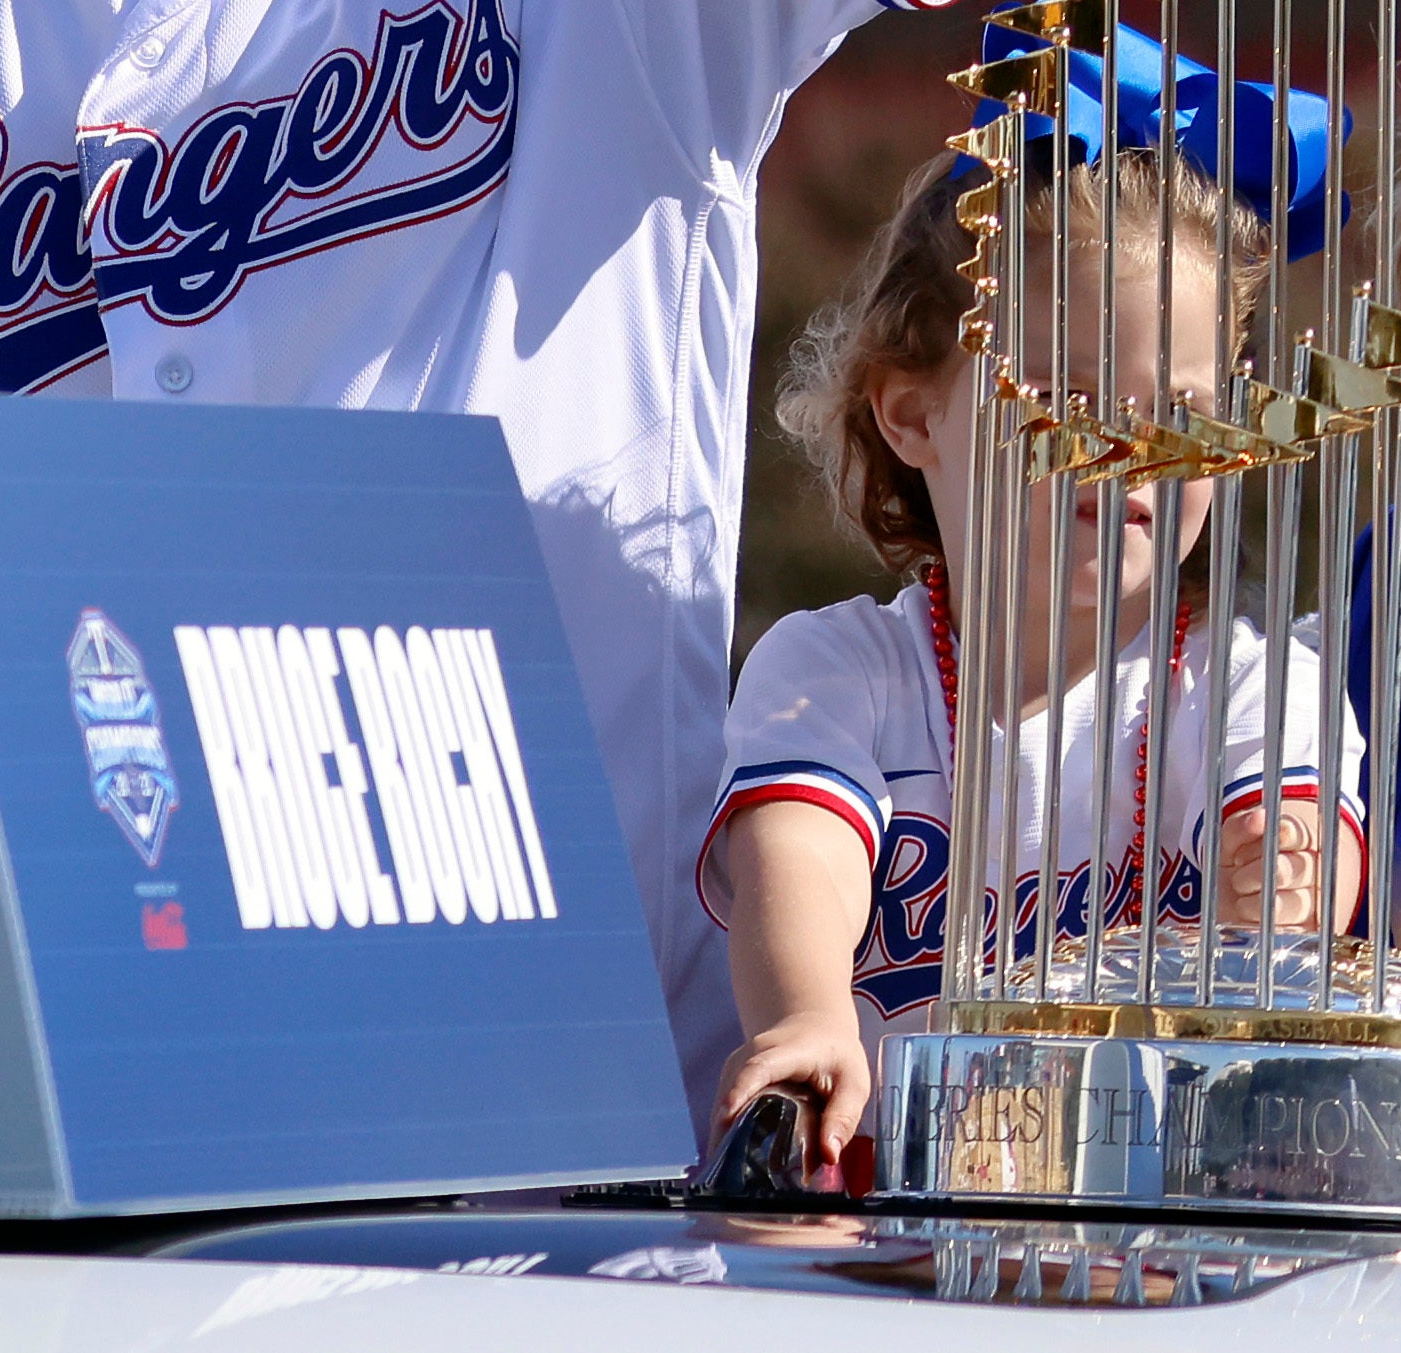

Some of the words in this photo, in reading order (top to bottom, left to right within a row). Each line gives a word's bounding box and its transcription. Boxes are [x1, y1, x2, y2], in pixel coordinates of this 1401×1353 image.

[173, 625, 400, 930] BRUCE
[337, 625, 558, 925] BOCHY
[910, 1084, 1044, 1144] ERIES
